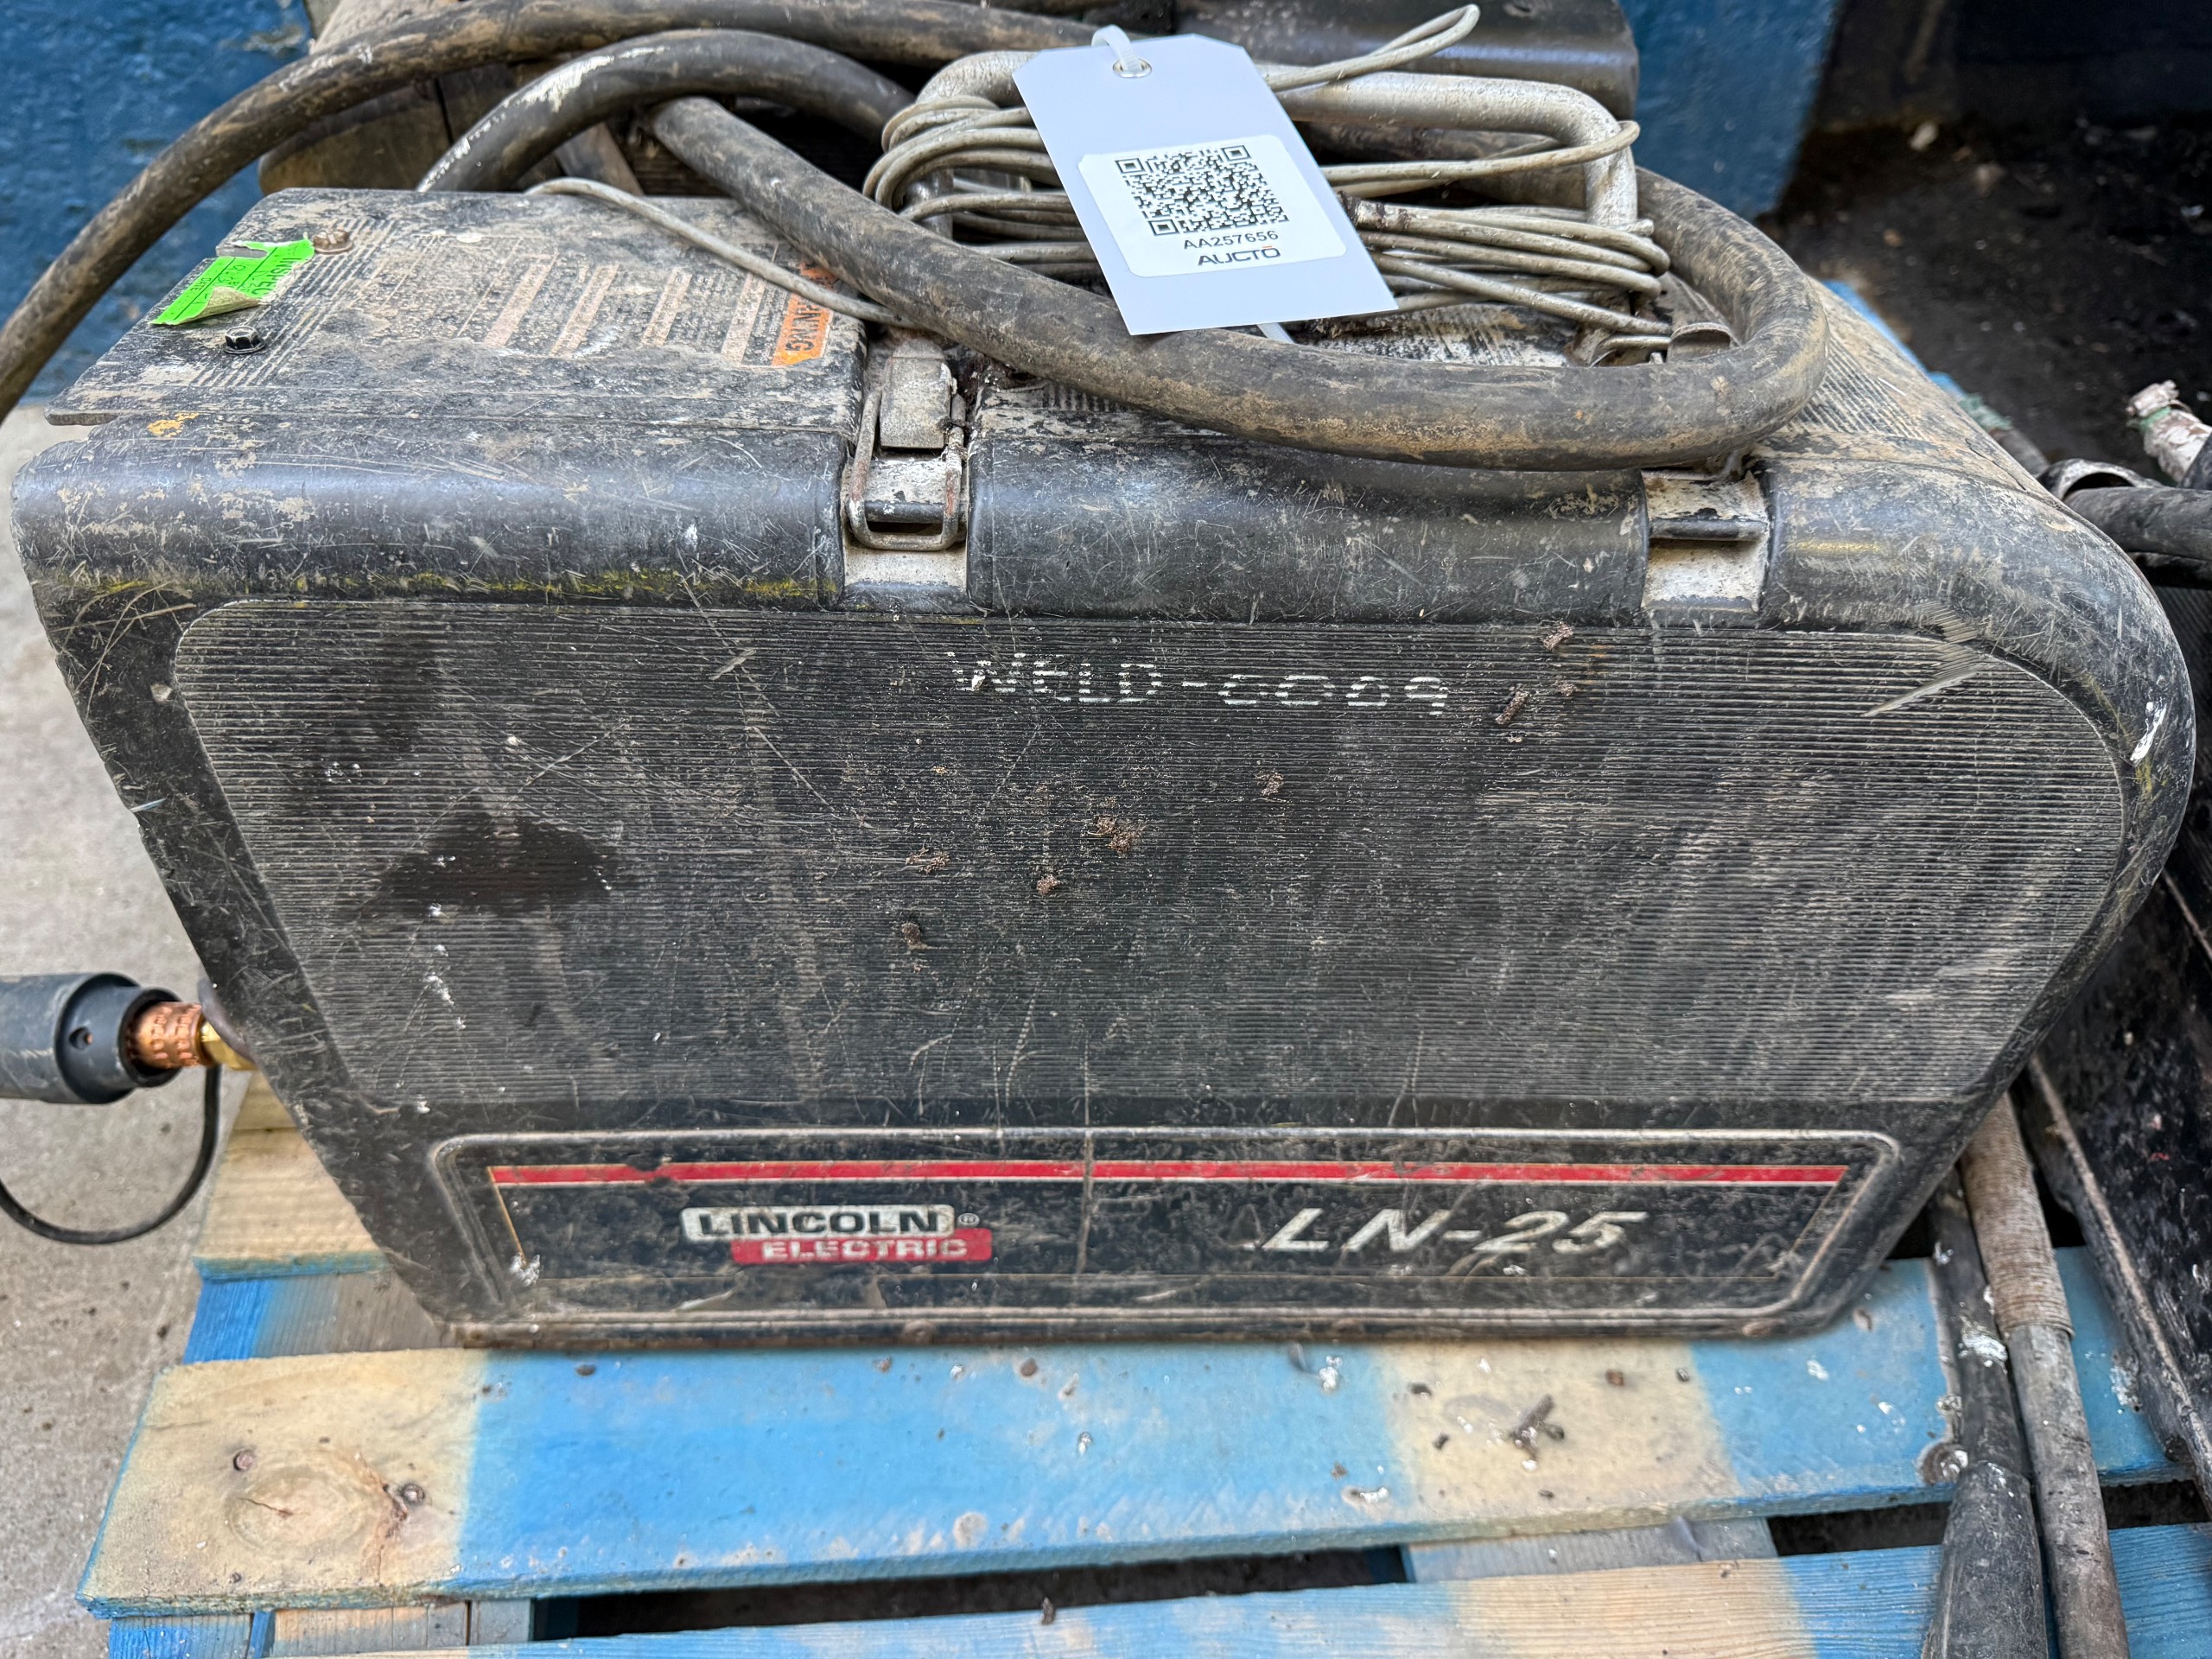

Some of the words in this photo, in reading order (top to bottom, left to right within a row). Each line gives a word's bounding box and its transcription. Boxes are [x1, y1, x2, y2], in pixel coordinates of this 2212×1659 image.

[1184, 230, 1279, 250] AA257656
[699, 1211, 938, 1235] LINCOLN
[1262, 1208, 1648, 1253] LN-25
[762, 1238, 968, 1259] ELECTRIC
